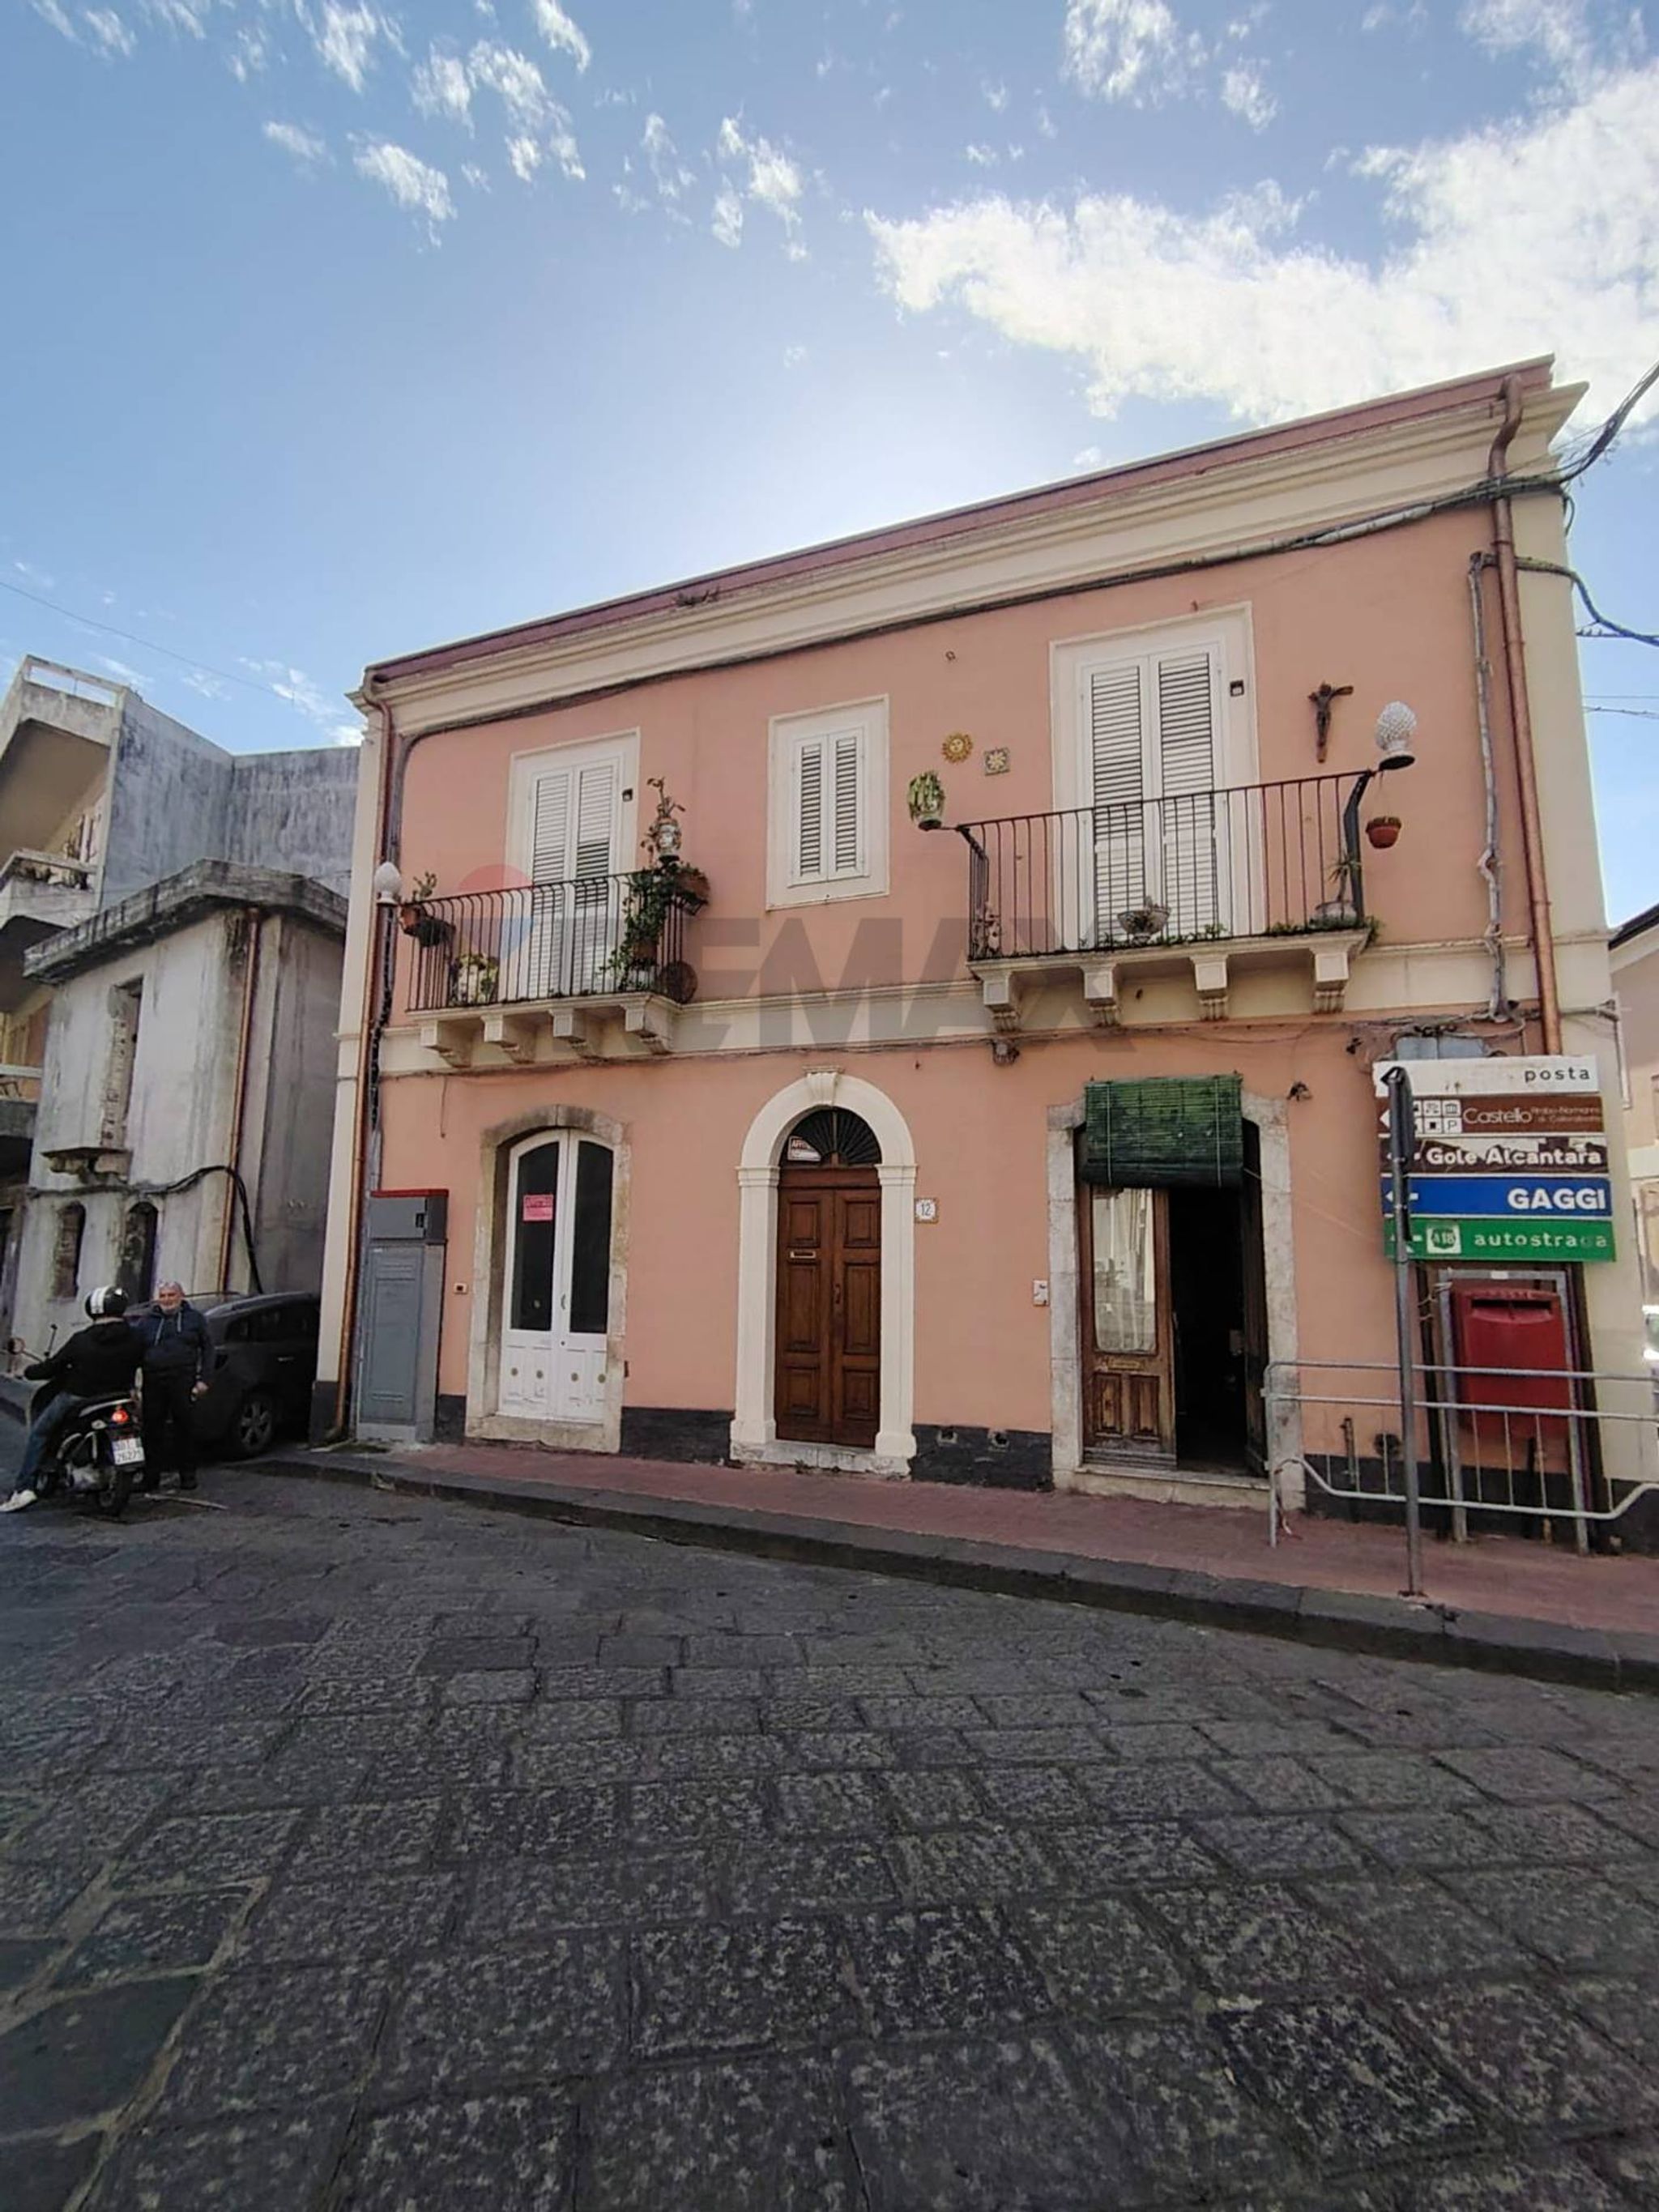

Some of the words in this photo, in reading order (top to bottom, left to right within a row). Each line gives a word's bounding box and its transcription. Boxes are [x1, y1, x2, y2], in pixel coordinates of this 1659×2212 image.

[1524, 1065, 1590, 1083] posta
[1426, 1147, 1478, 1165] Gole
[1485, 1145, 1602, 1165] Alcantara
[1507, 1188, 1606, 1209] GAGGI
[921, 1203, 932, 1217] 12
